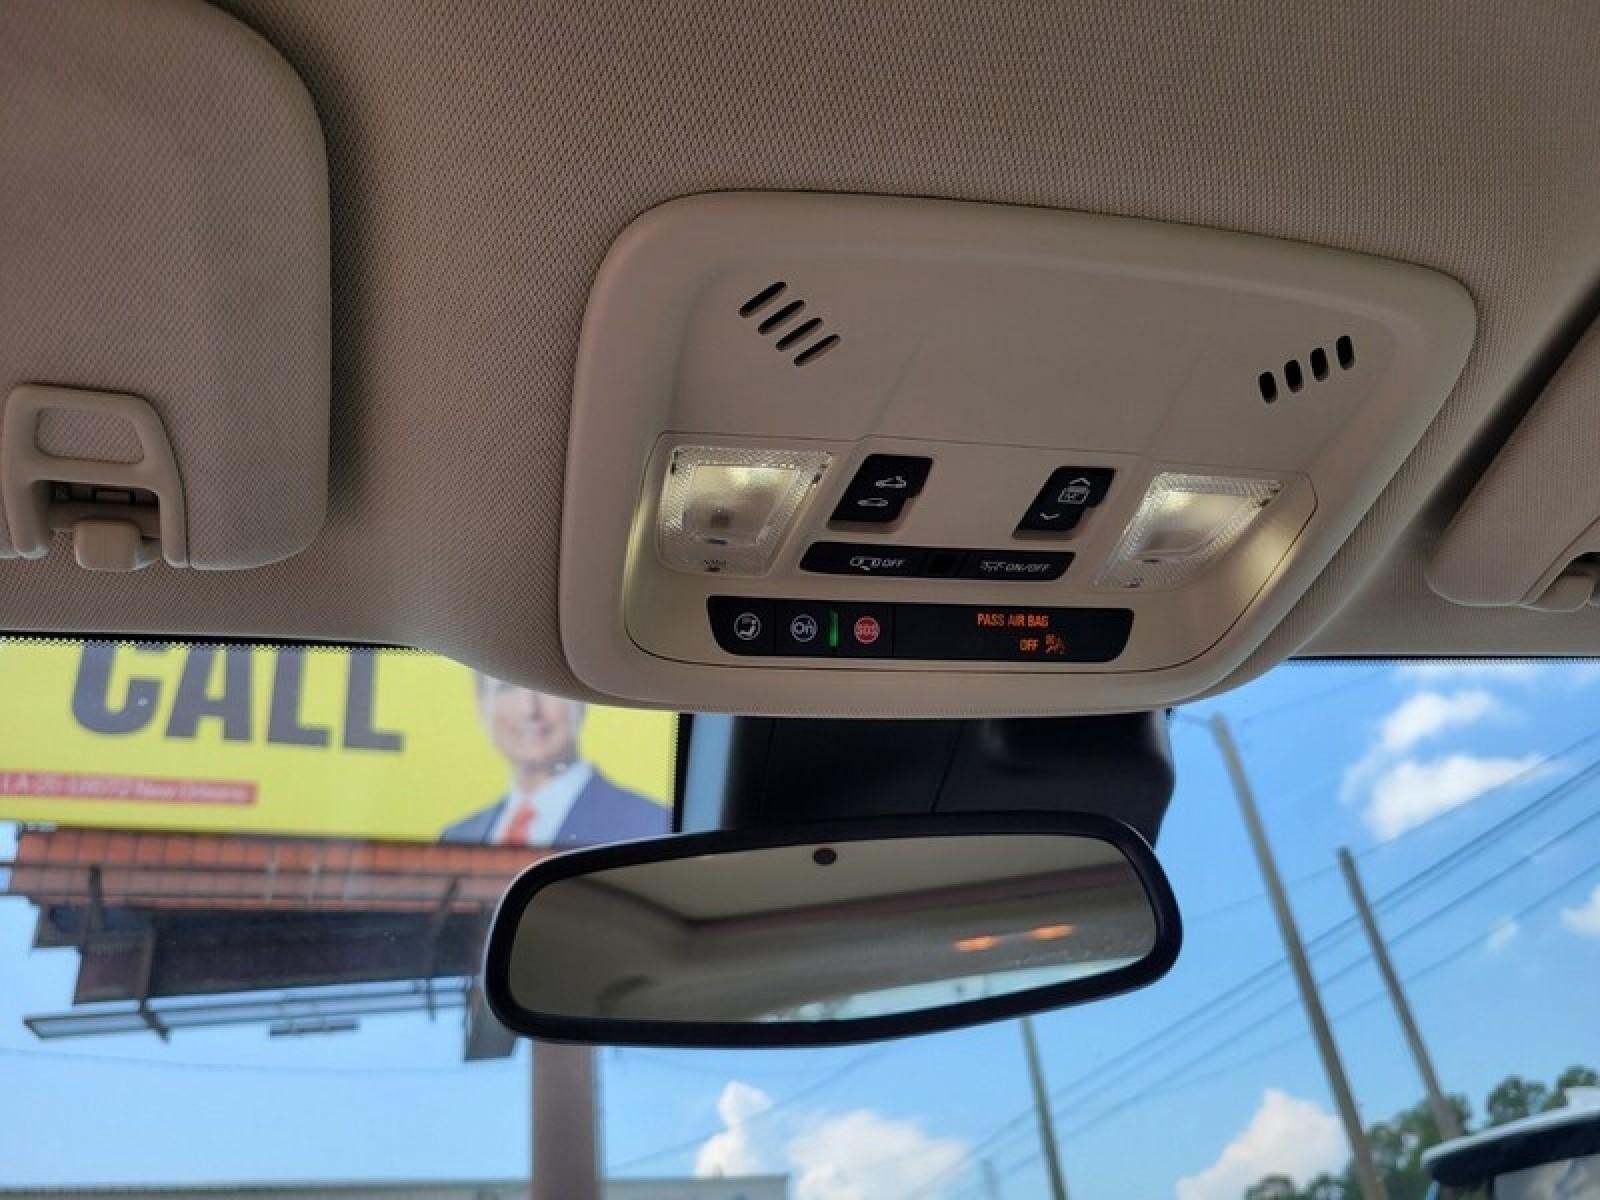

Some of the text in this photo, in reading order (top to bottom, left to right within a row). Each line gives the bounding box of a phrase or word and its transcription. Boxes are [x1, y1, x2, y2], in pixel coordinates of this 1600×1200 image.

[881, 559, 905, 568] OFF
[1006, 563, 1050, 573] ON/OFF
[977, 613, 1049, 627] PASS AIR BAG
[856, 623, 878, 636] SOS
[1020, 639, 1039, 651] OFF
[71, 638, 404, 752] CALL
